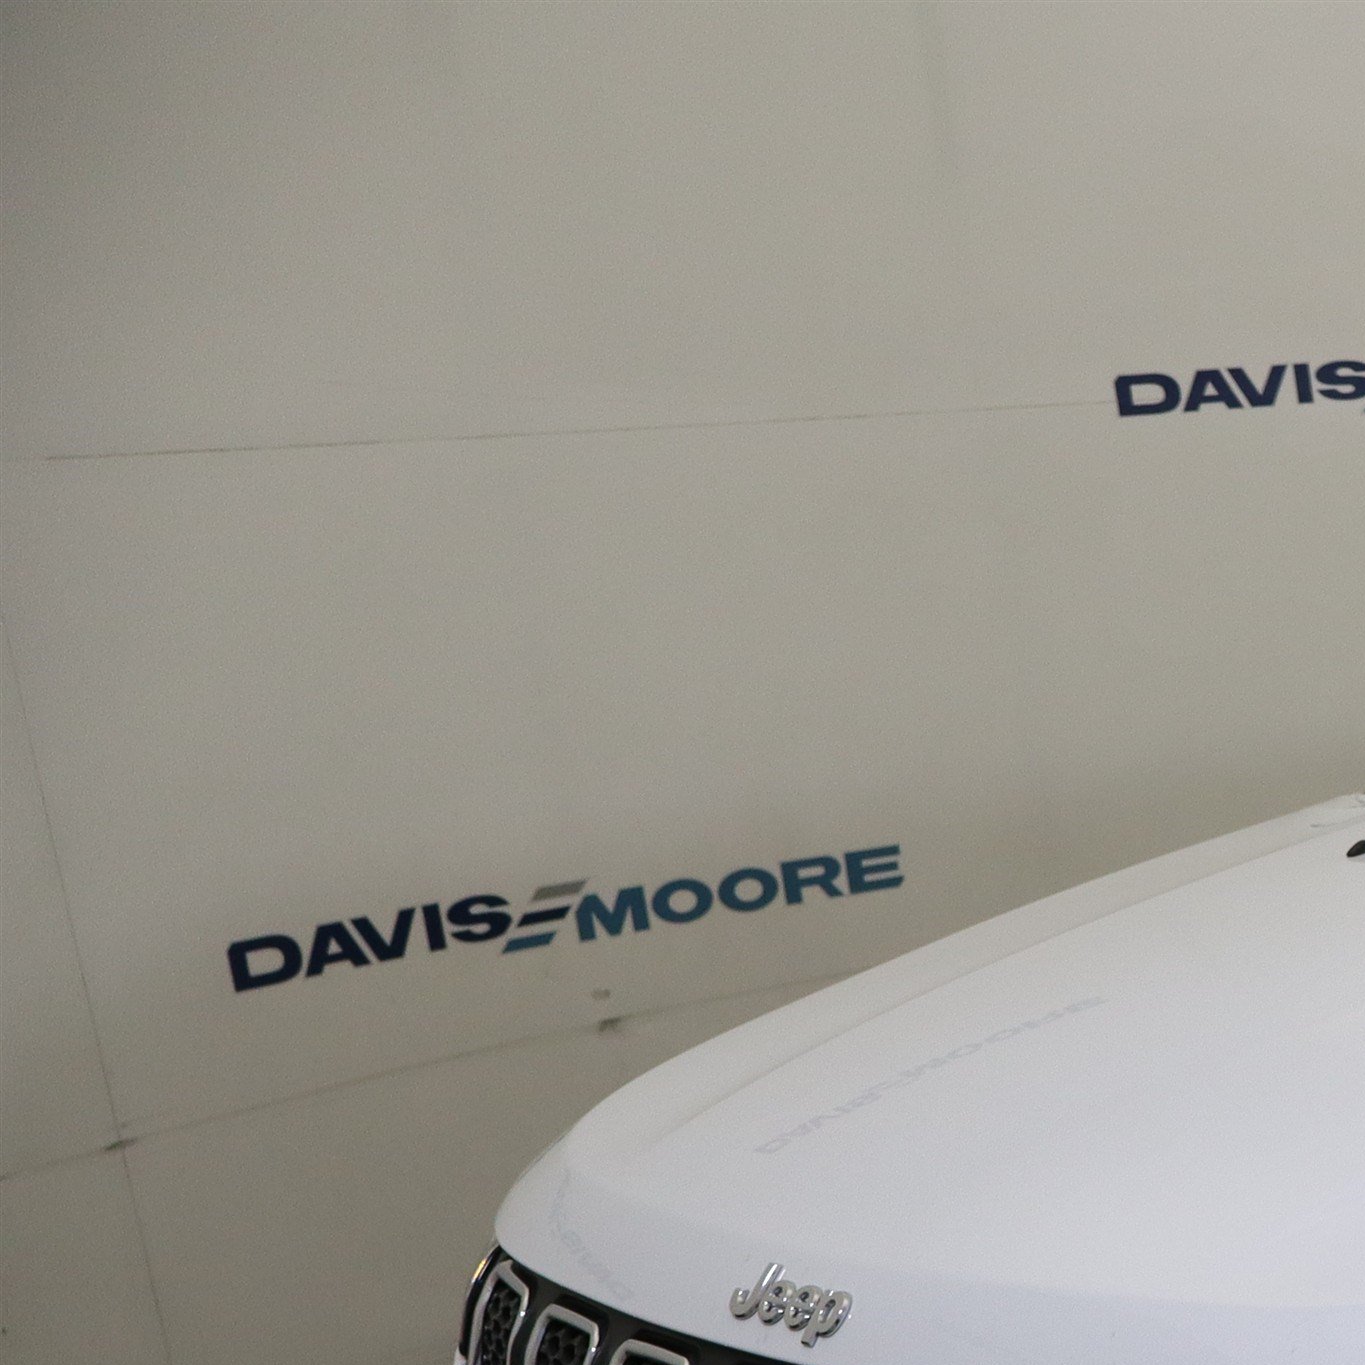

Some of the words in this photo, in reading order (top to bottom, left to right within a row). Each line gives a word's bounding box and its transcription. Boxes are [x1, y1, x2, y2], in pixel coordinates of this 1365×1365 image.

[227, 894, 512, 993] DAVIS
[575, 844, 905, 943] MOORE
[729, 1262, 853, 1348] Jeep
